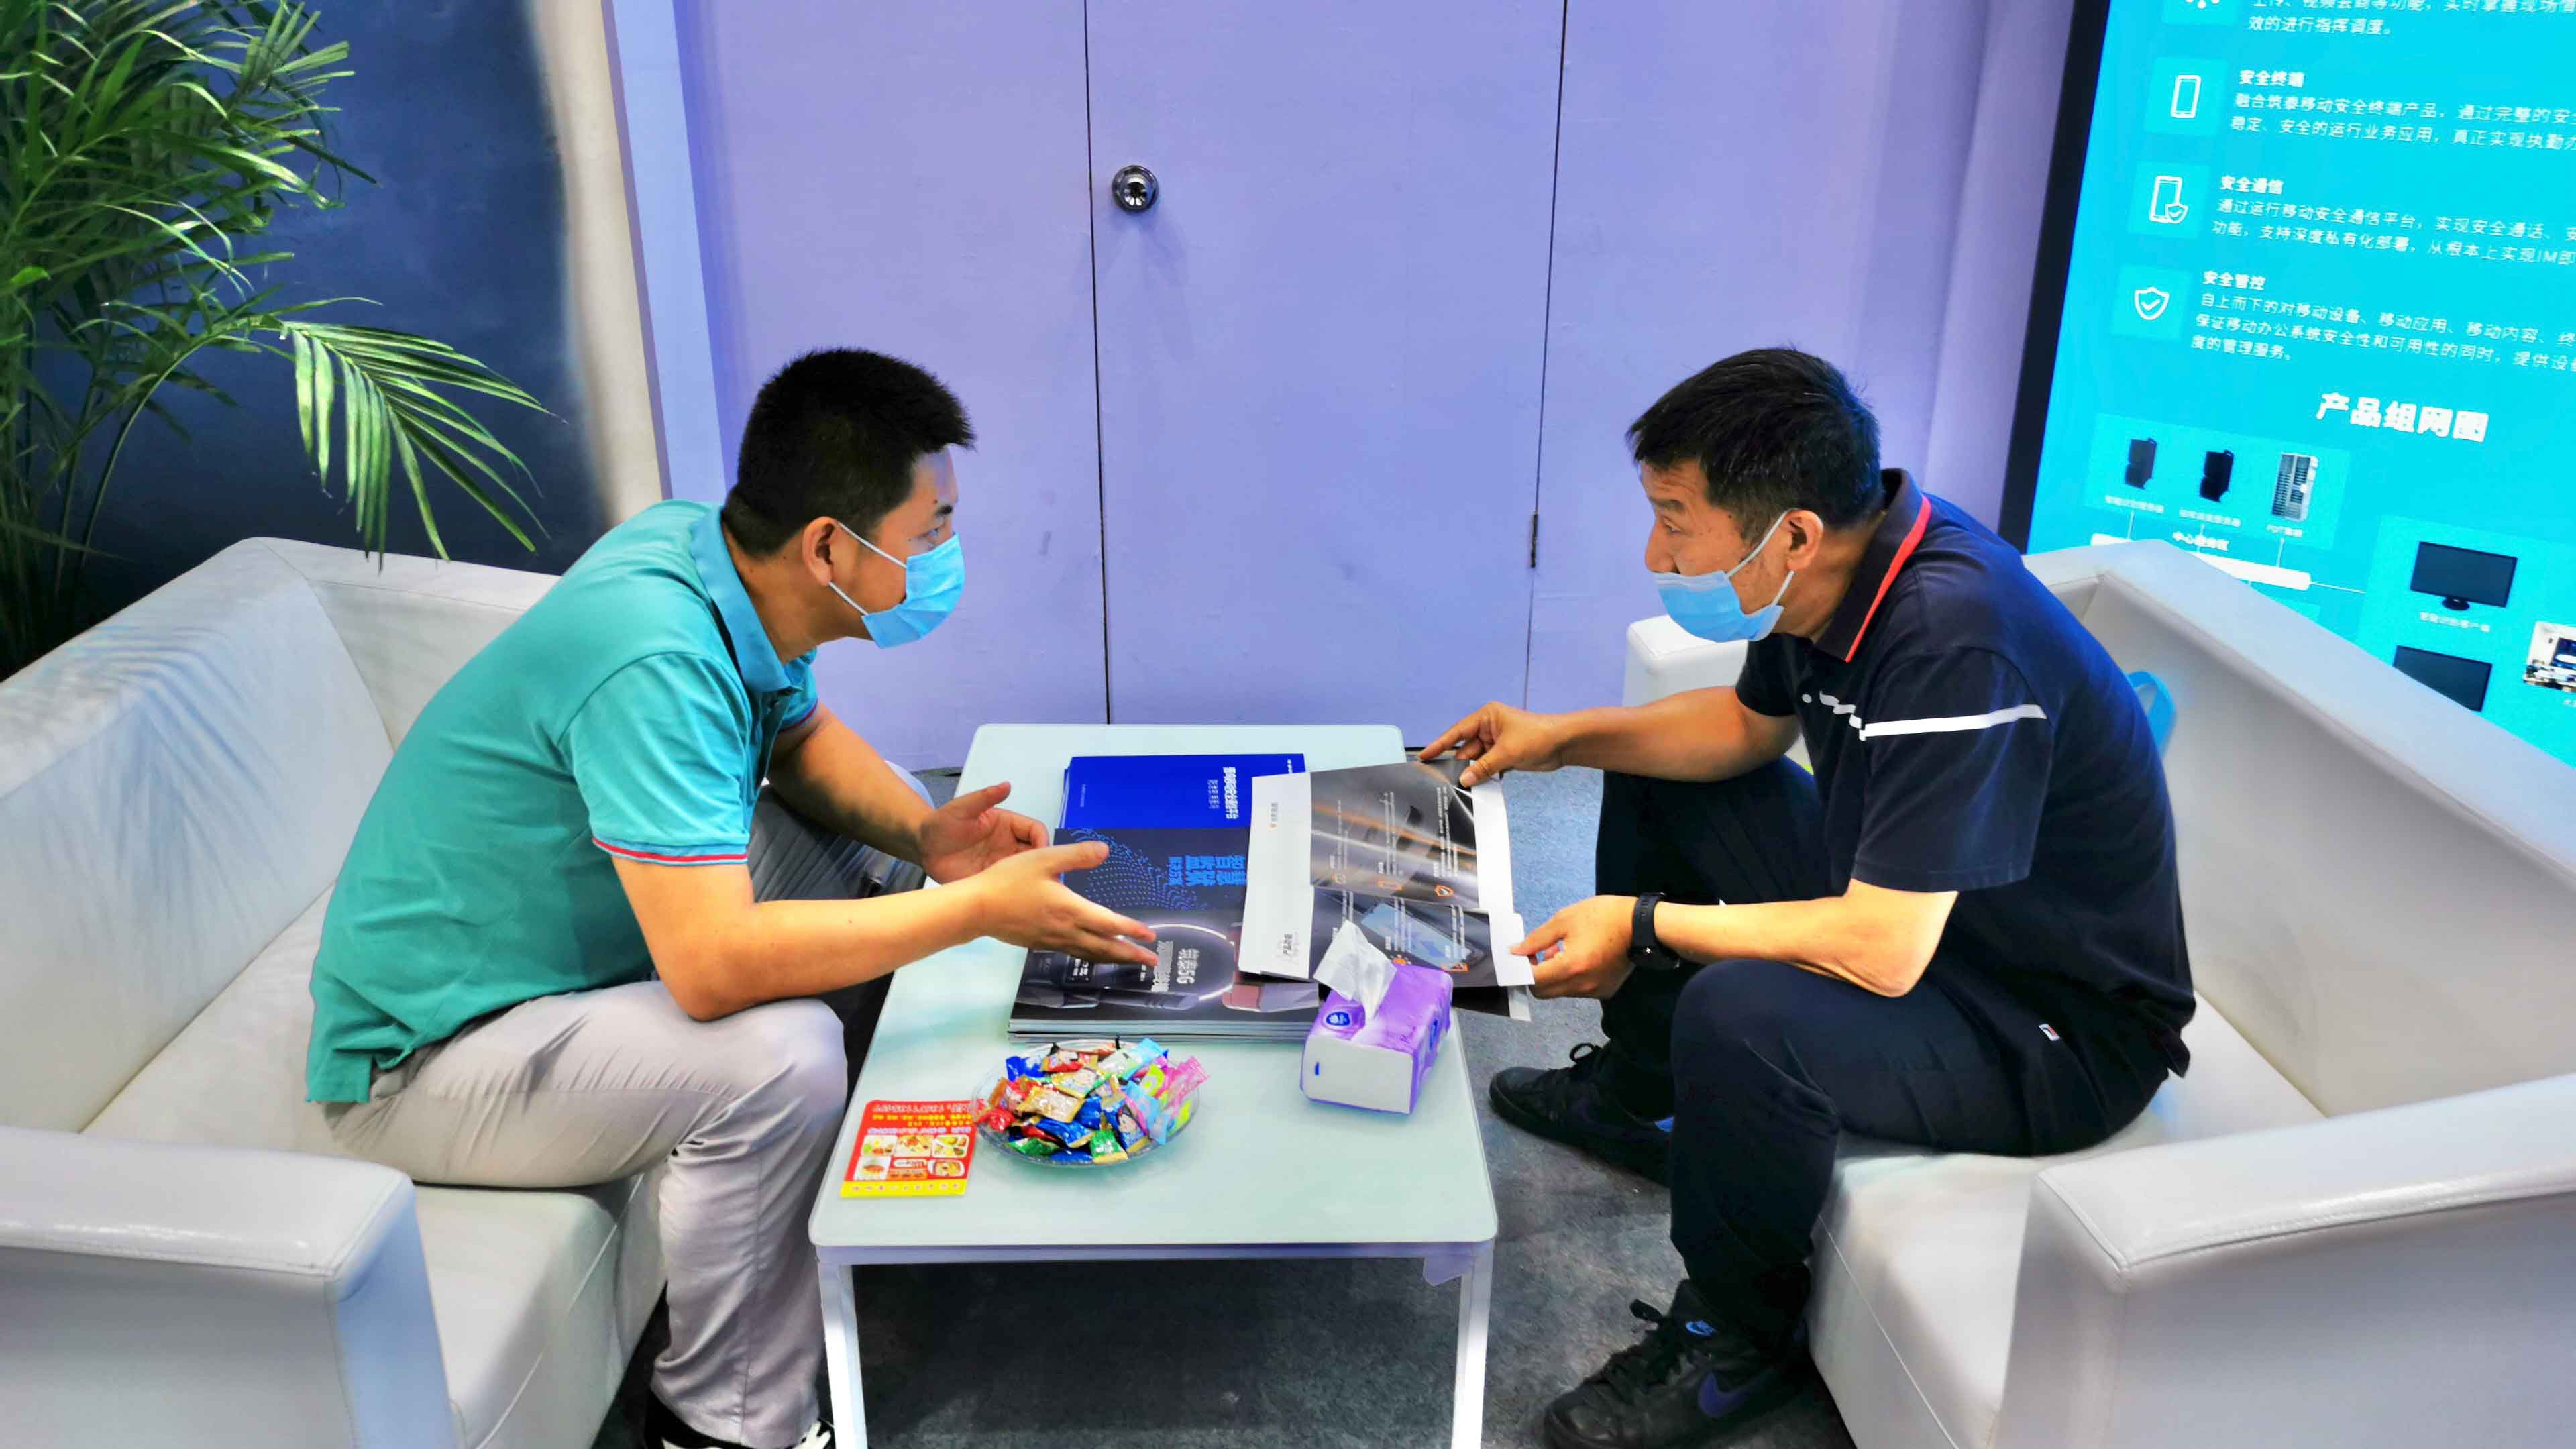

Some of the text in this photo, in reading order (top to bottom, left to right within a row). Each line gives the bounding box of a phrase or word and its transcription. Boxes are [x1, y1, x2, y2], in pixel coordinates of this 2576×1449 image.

[2239, 69, 2306, 88] 安全终端
[2220, 175, 2284, 195] 安全通信
[2202, 270, 2267, 290] 安全管控
[2190, 334, 2292, 360] 度的管理服务。
[2316, 392, 2489, 443] 产品组网图
